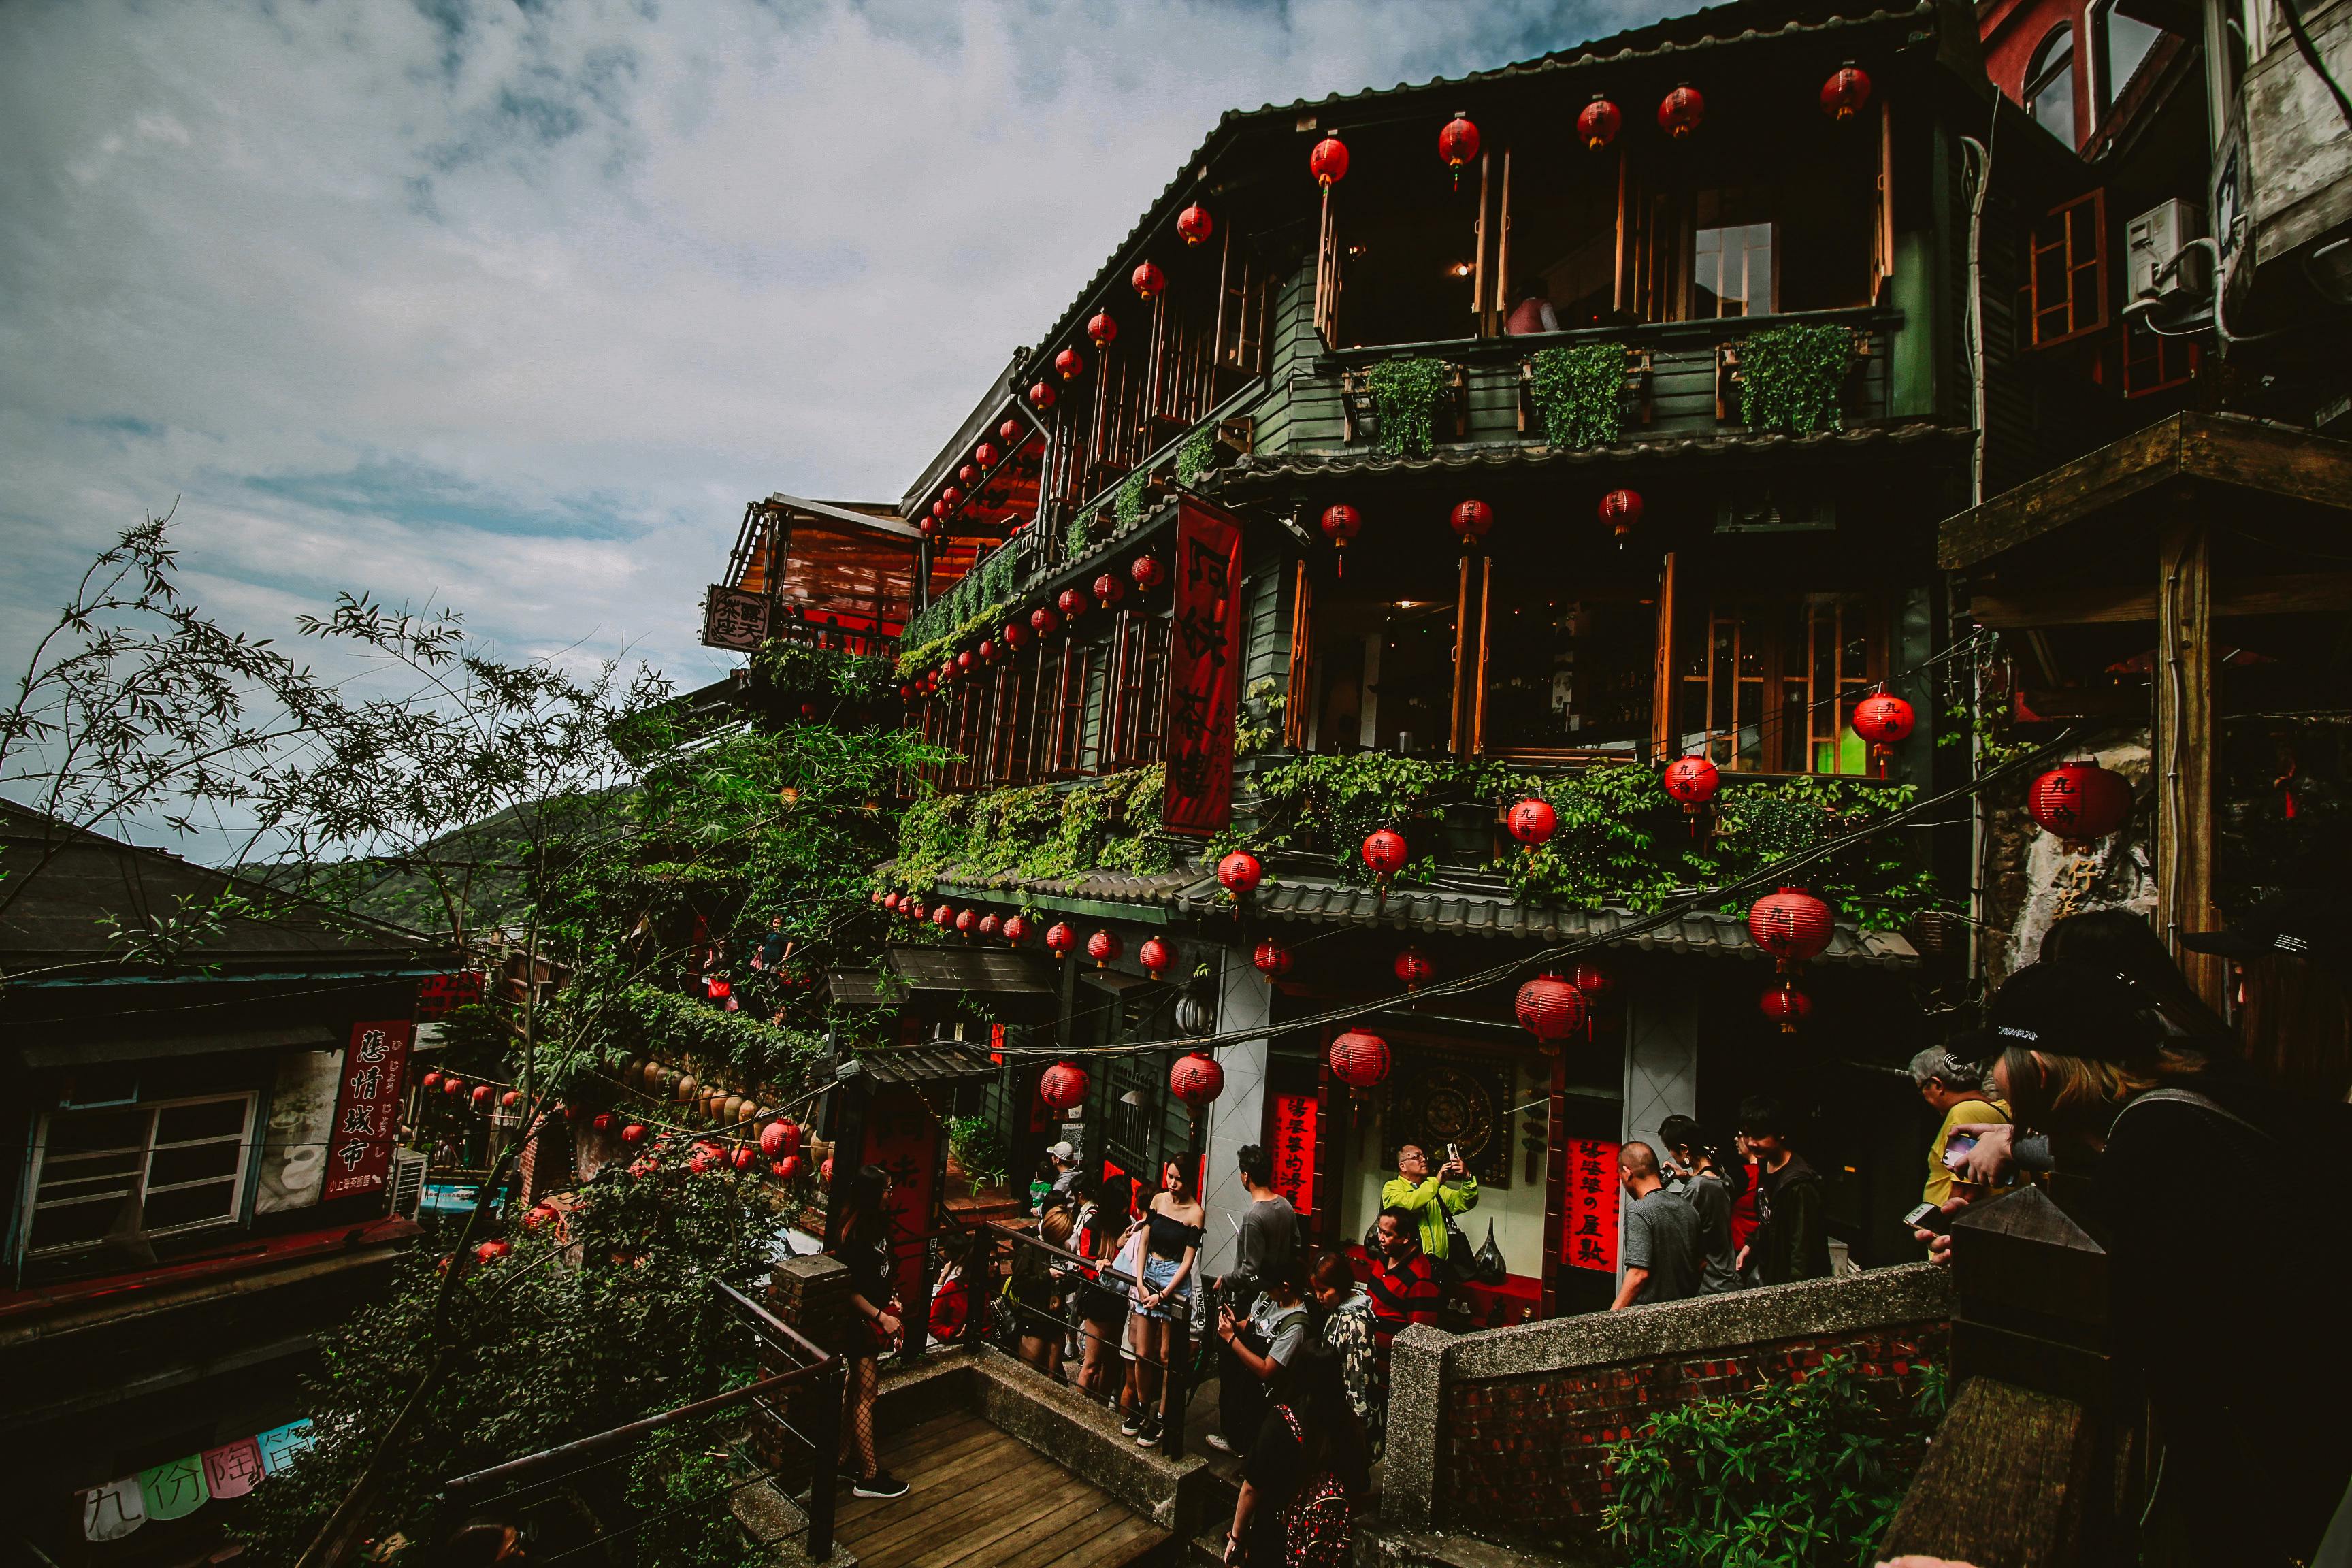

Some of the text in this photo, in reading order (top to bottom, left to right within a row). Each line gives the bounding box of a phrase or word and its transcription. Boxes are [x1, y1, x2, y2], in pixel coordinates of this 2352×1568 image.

[1172, 536, 1230, 797] 阿妹茶樓
[2050, 777, 2075, 824] 九份
[338, 1029, 389, 1172] 悲情城市
[329, 1175, 371, 1192] 小上海茶飯館
[1196, 1289, 1205, 1326] ORIGINAL
